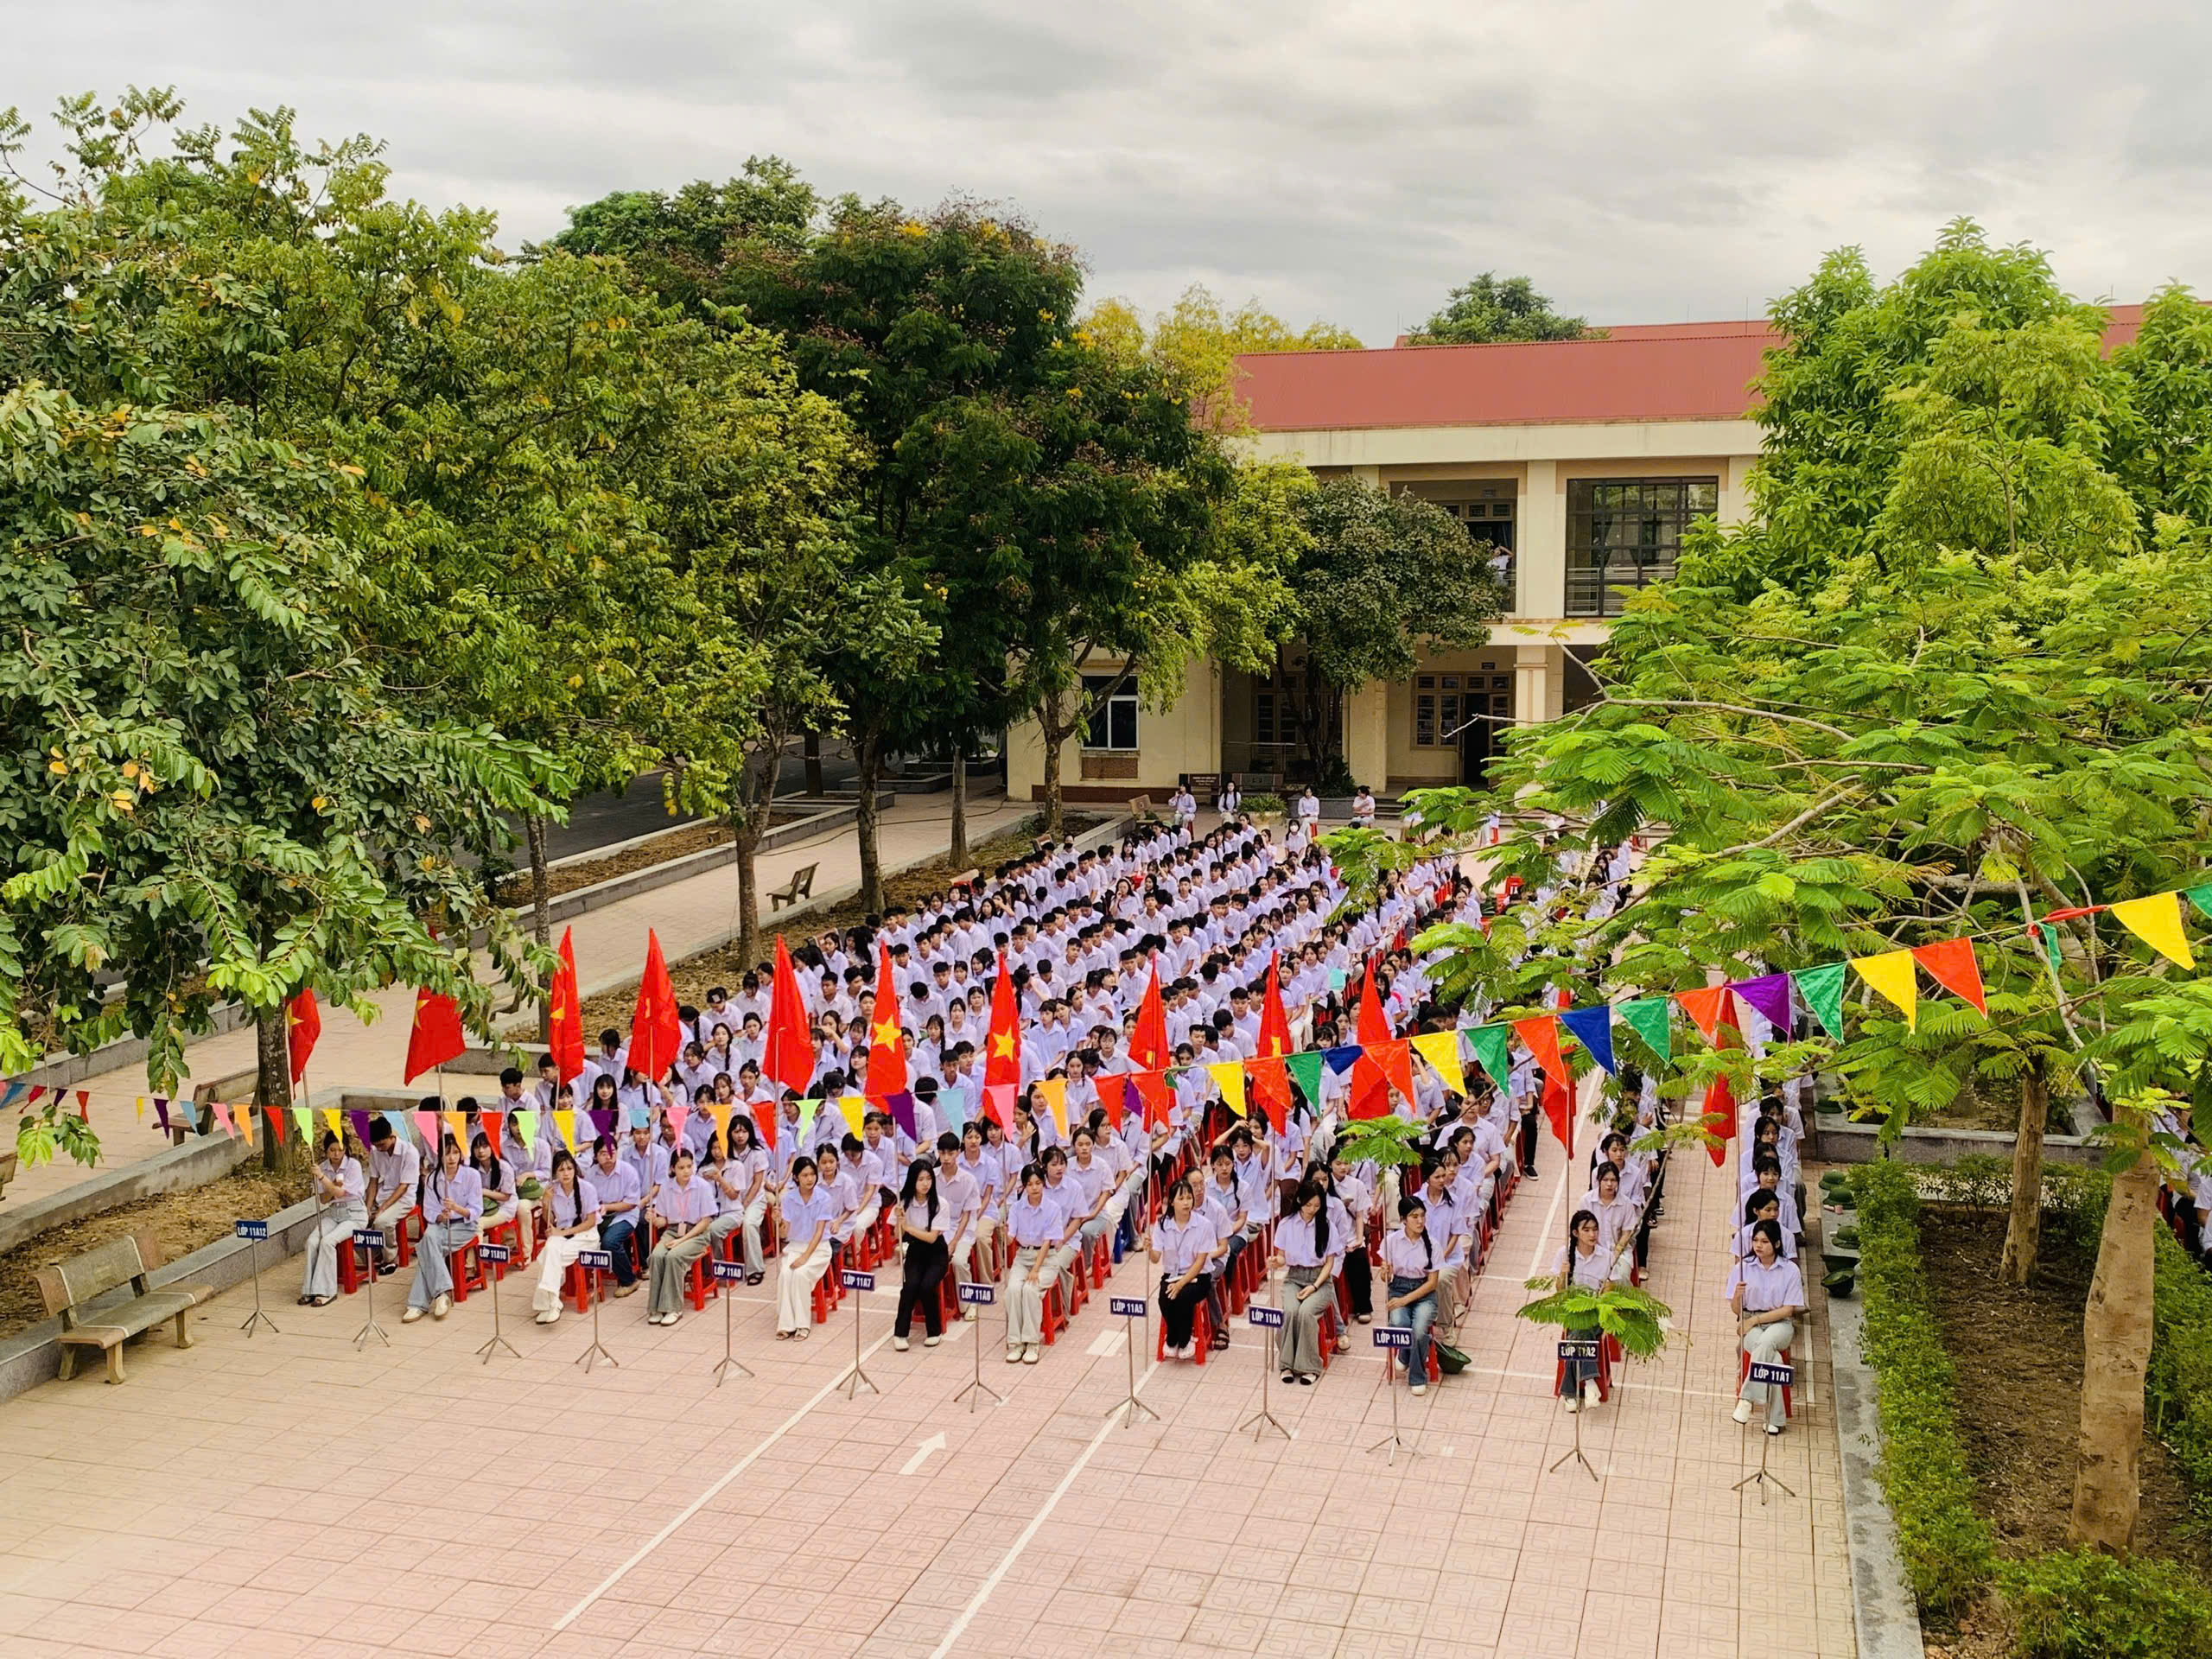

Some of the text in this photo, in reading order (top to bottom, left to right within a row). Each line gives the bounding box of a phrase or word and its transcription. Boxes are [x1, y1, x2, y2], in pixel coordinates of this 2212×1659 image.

[249, 1227, 266, 1236] 11A12
[365, 1236, 383, 1246] 11A11
[856, 1276, 872, 1287] 11A7
[1127, 1303, 1143, 1313] 11A5
[1265, 1313, 1281, 1325] 11A4
[1391, 1333, 1410, 1344] 11A3
[1770, 1370, 1789, 1382] 11A1
